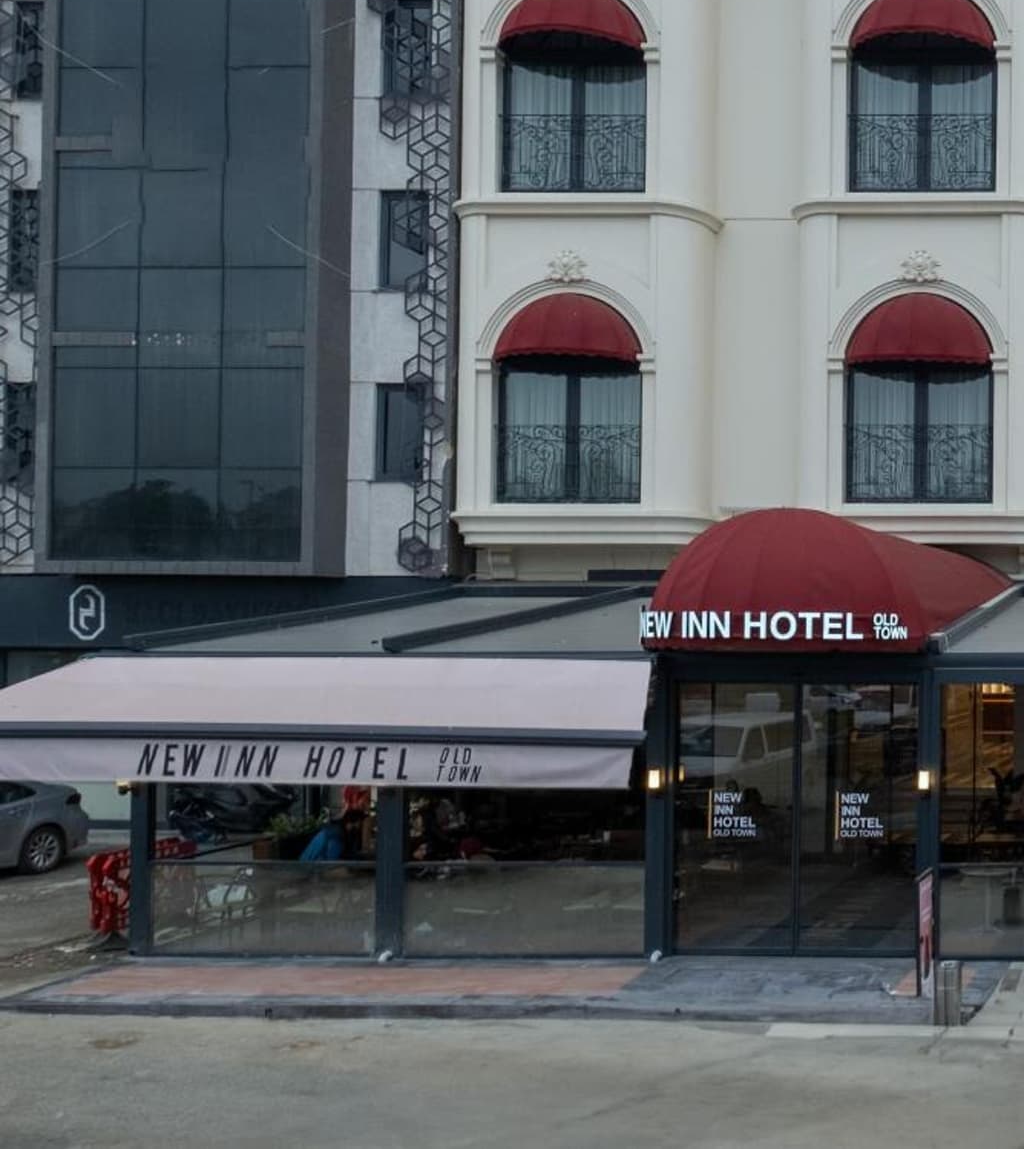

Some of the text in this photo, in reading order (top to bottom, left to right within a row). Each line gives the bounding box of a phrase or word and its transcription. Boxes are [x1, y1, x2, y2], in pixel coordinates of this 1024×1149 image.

[873, 612, 899, 626] OLD
[640, 610, 864, 640] NEW INN HOTEL
[873, 626, 908, 640] TOWN
[440, 747, 472, 765] OLD
[136, 743, 409, 781] NEW INN HOTEL
[436, 765, 482, 783] TOWN
[714, 792, 742, 803] NEW
[841, 793, 869, 804] NEW
[714, 805, 733, 815] INN
[841, 806, 860, 816] INN
[713, 817, 756, 828] HOTEL
[840, 818, 883, 829] HOTEL
[713, 829, 756, 837] OLD TOWN
[840, 830, 883, 838] OLD TOWN
